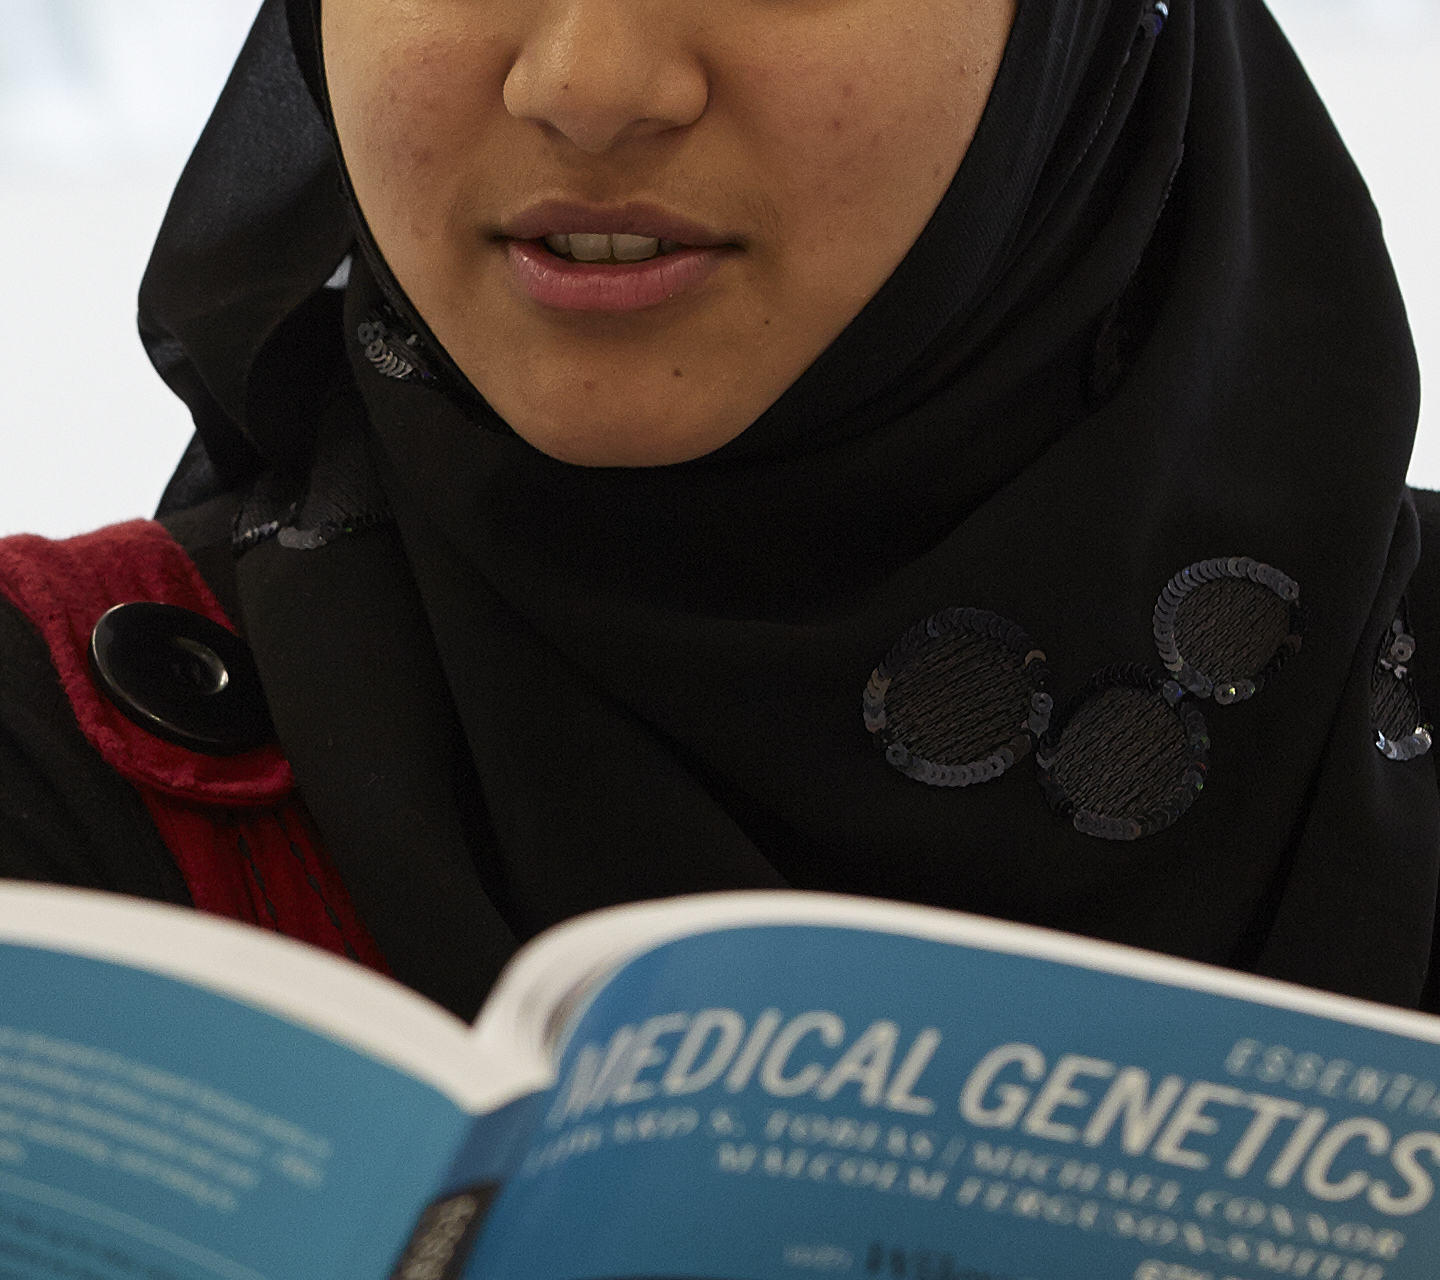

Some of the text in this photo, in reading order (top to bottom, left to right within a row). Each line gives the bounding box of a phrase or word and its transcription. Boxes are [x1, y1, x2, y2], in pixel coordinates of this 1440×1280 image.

[545, 1006, 942, 1128] MEDICAL
[718, 1142, 948, 1200] MALCOLM
[973, 1140, 1181, 1210] MICHAEL
[1194, 1190, 1406, 1261] CONNOR
